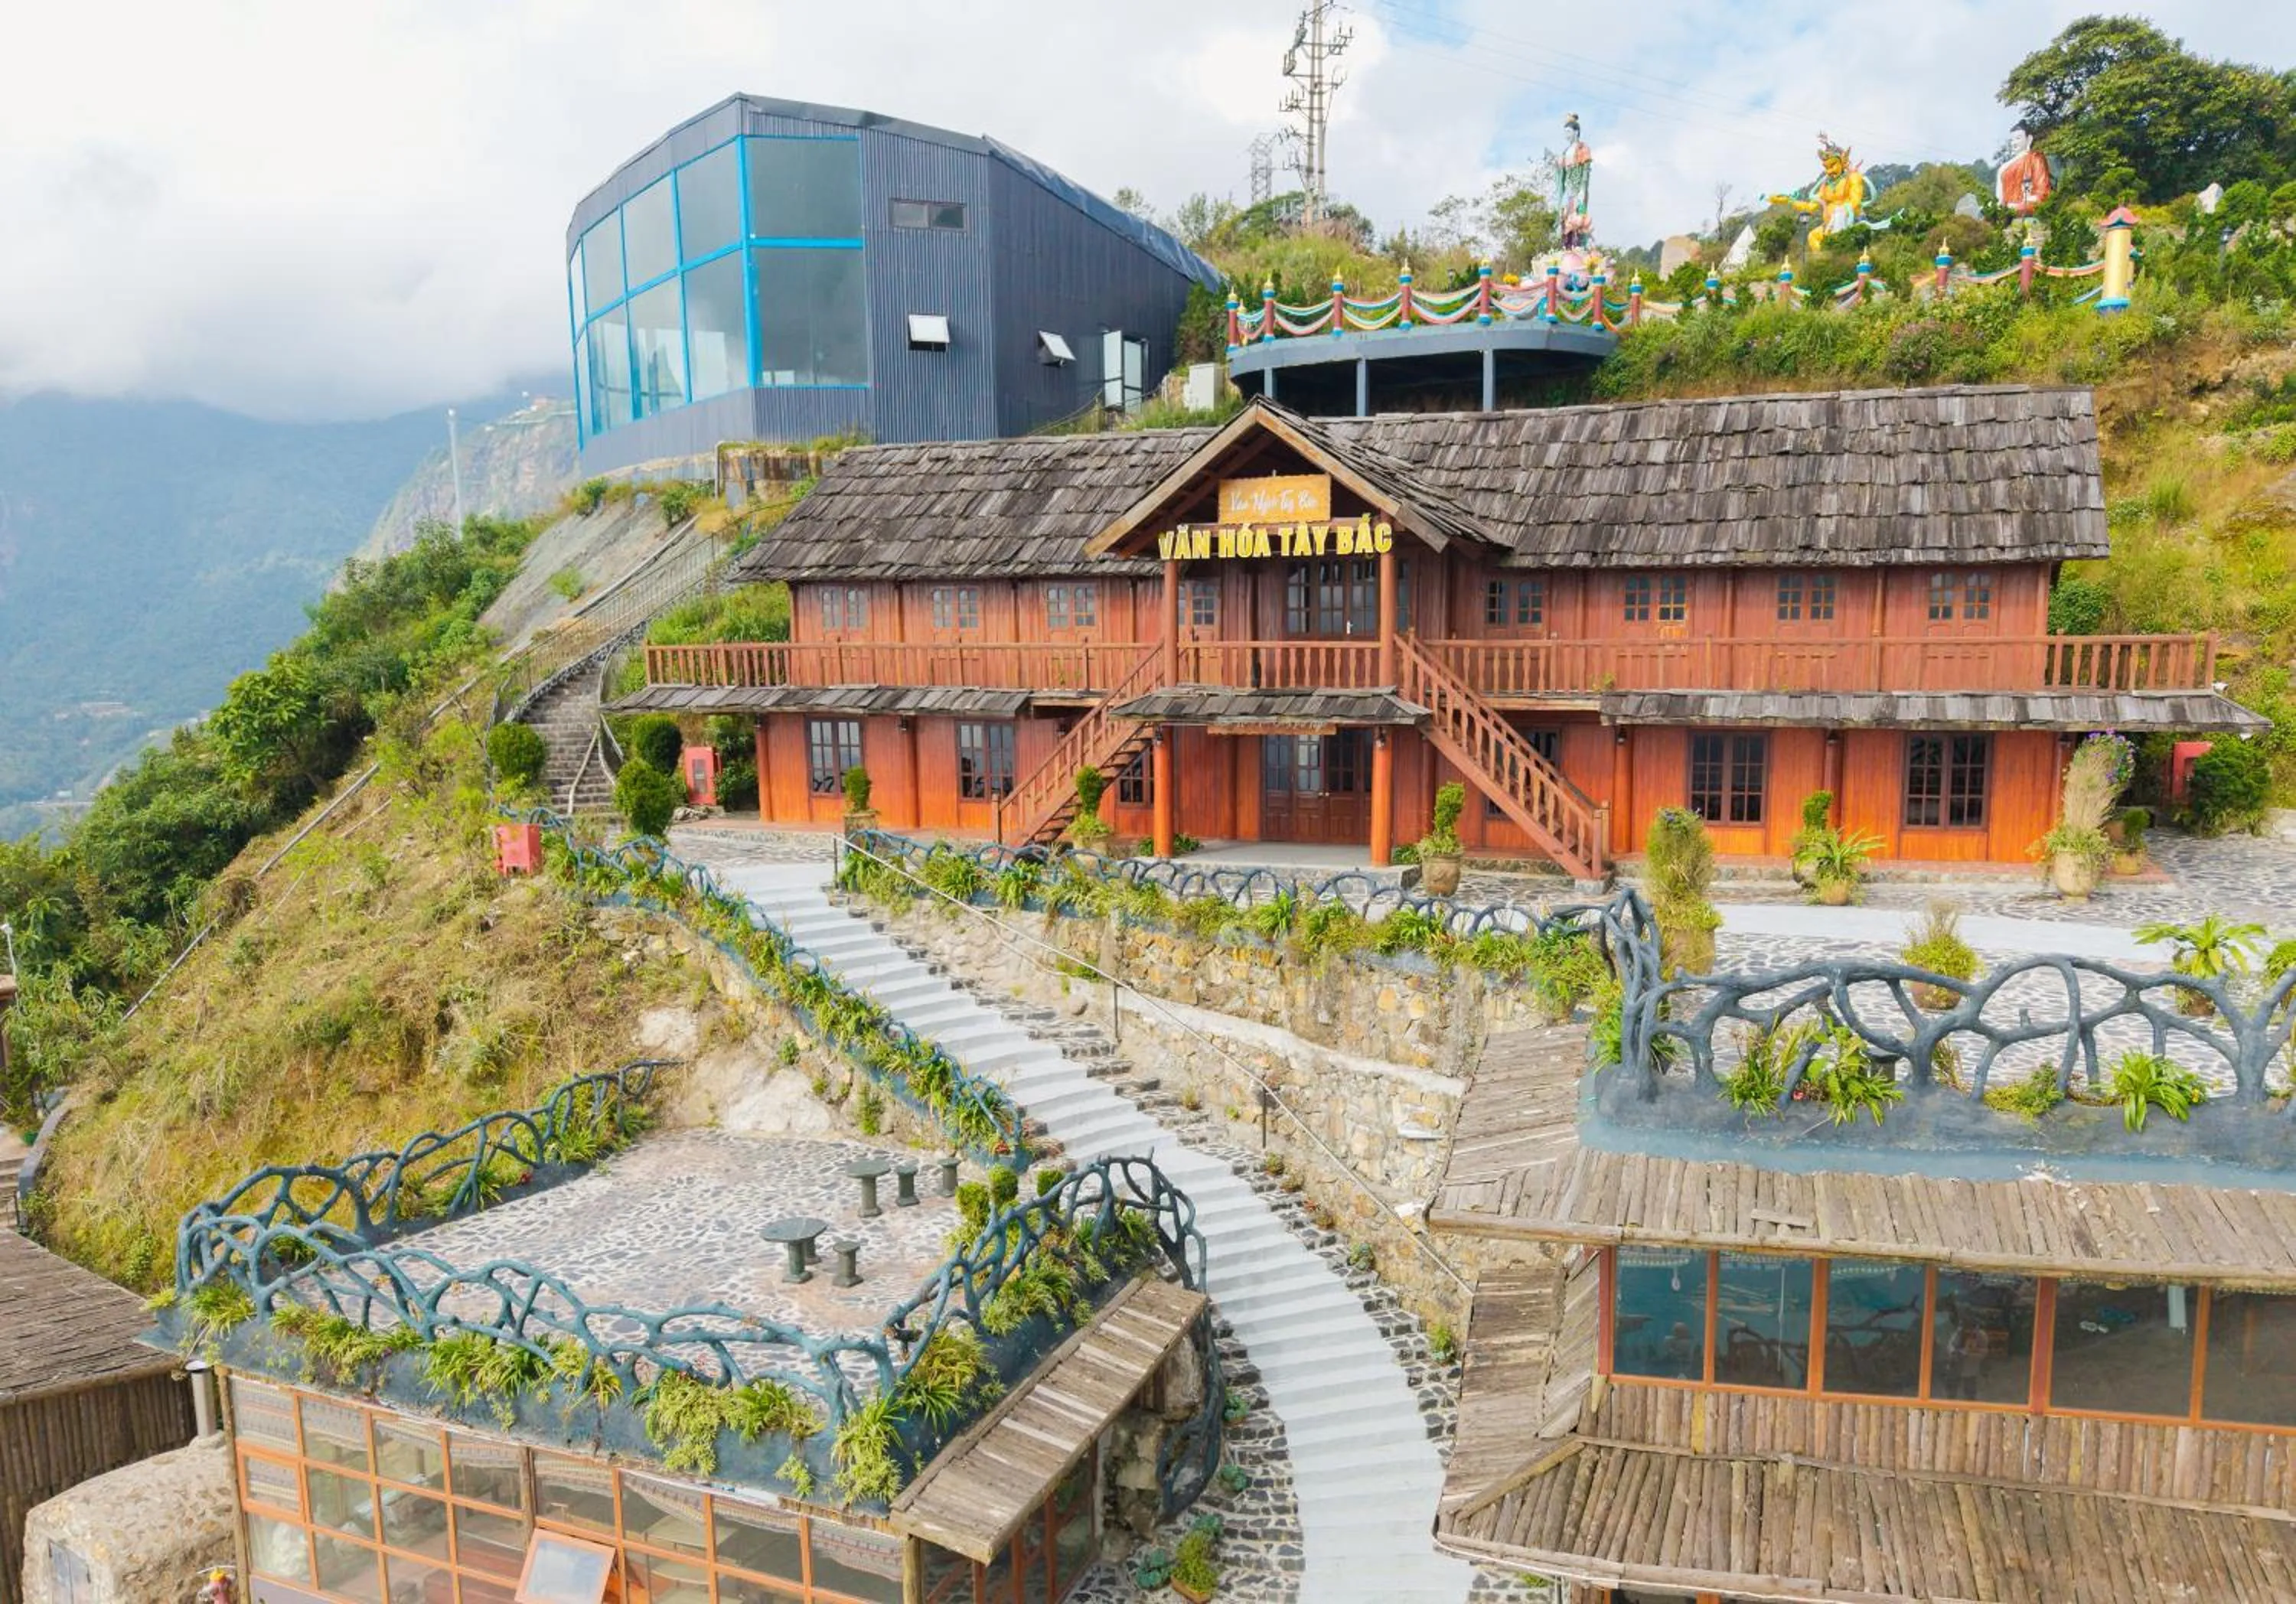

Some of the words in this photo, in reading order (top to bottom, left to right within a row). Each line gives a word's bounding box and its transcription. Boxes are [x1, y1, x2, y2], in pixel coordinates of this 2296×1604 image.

[1158, 524, 1211, 559] VĂN
[1218, 522, 1271, 557] HÓA
[1277, 520, 1330, 556] TÂY
[1336, 512, 1393, 555] BẮC
